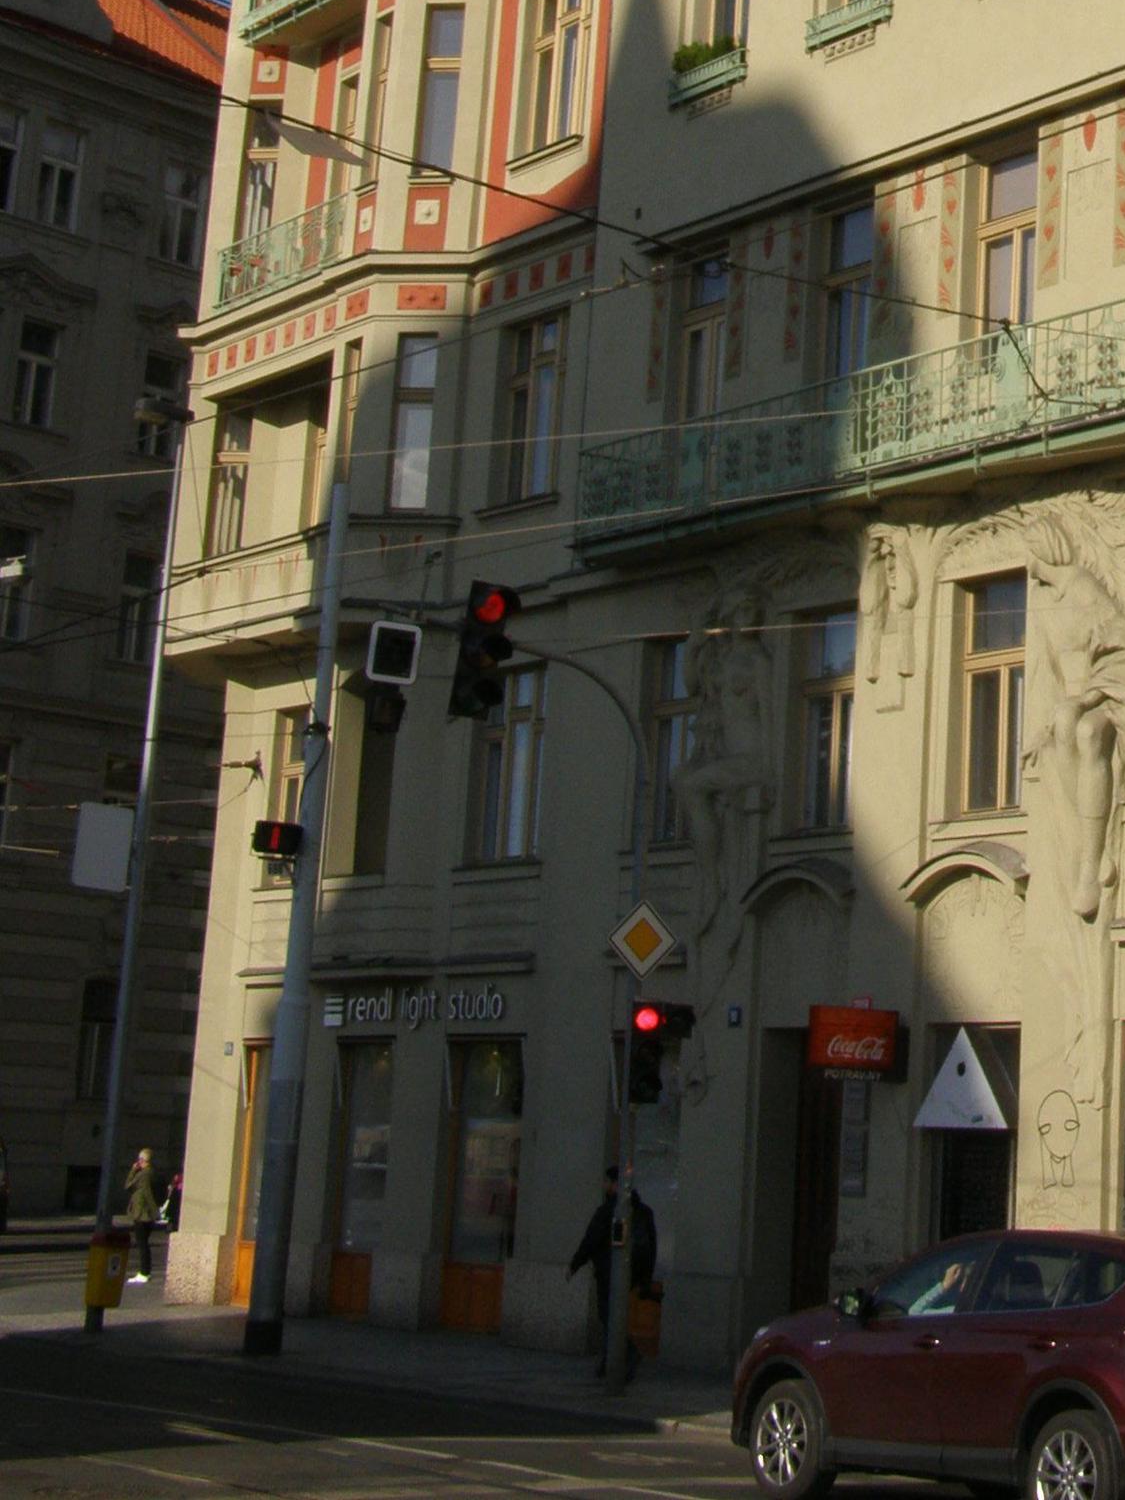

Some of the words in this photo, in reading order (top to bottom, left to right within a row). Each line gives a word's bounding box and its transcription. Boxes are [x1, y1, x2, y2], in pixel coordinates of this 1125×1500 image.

[347, 987, 393, 1021] rendl
[401, 986, 437, 1029] light
[449, 983, 503, 1019] studio
